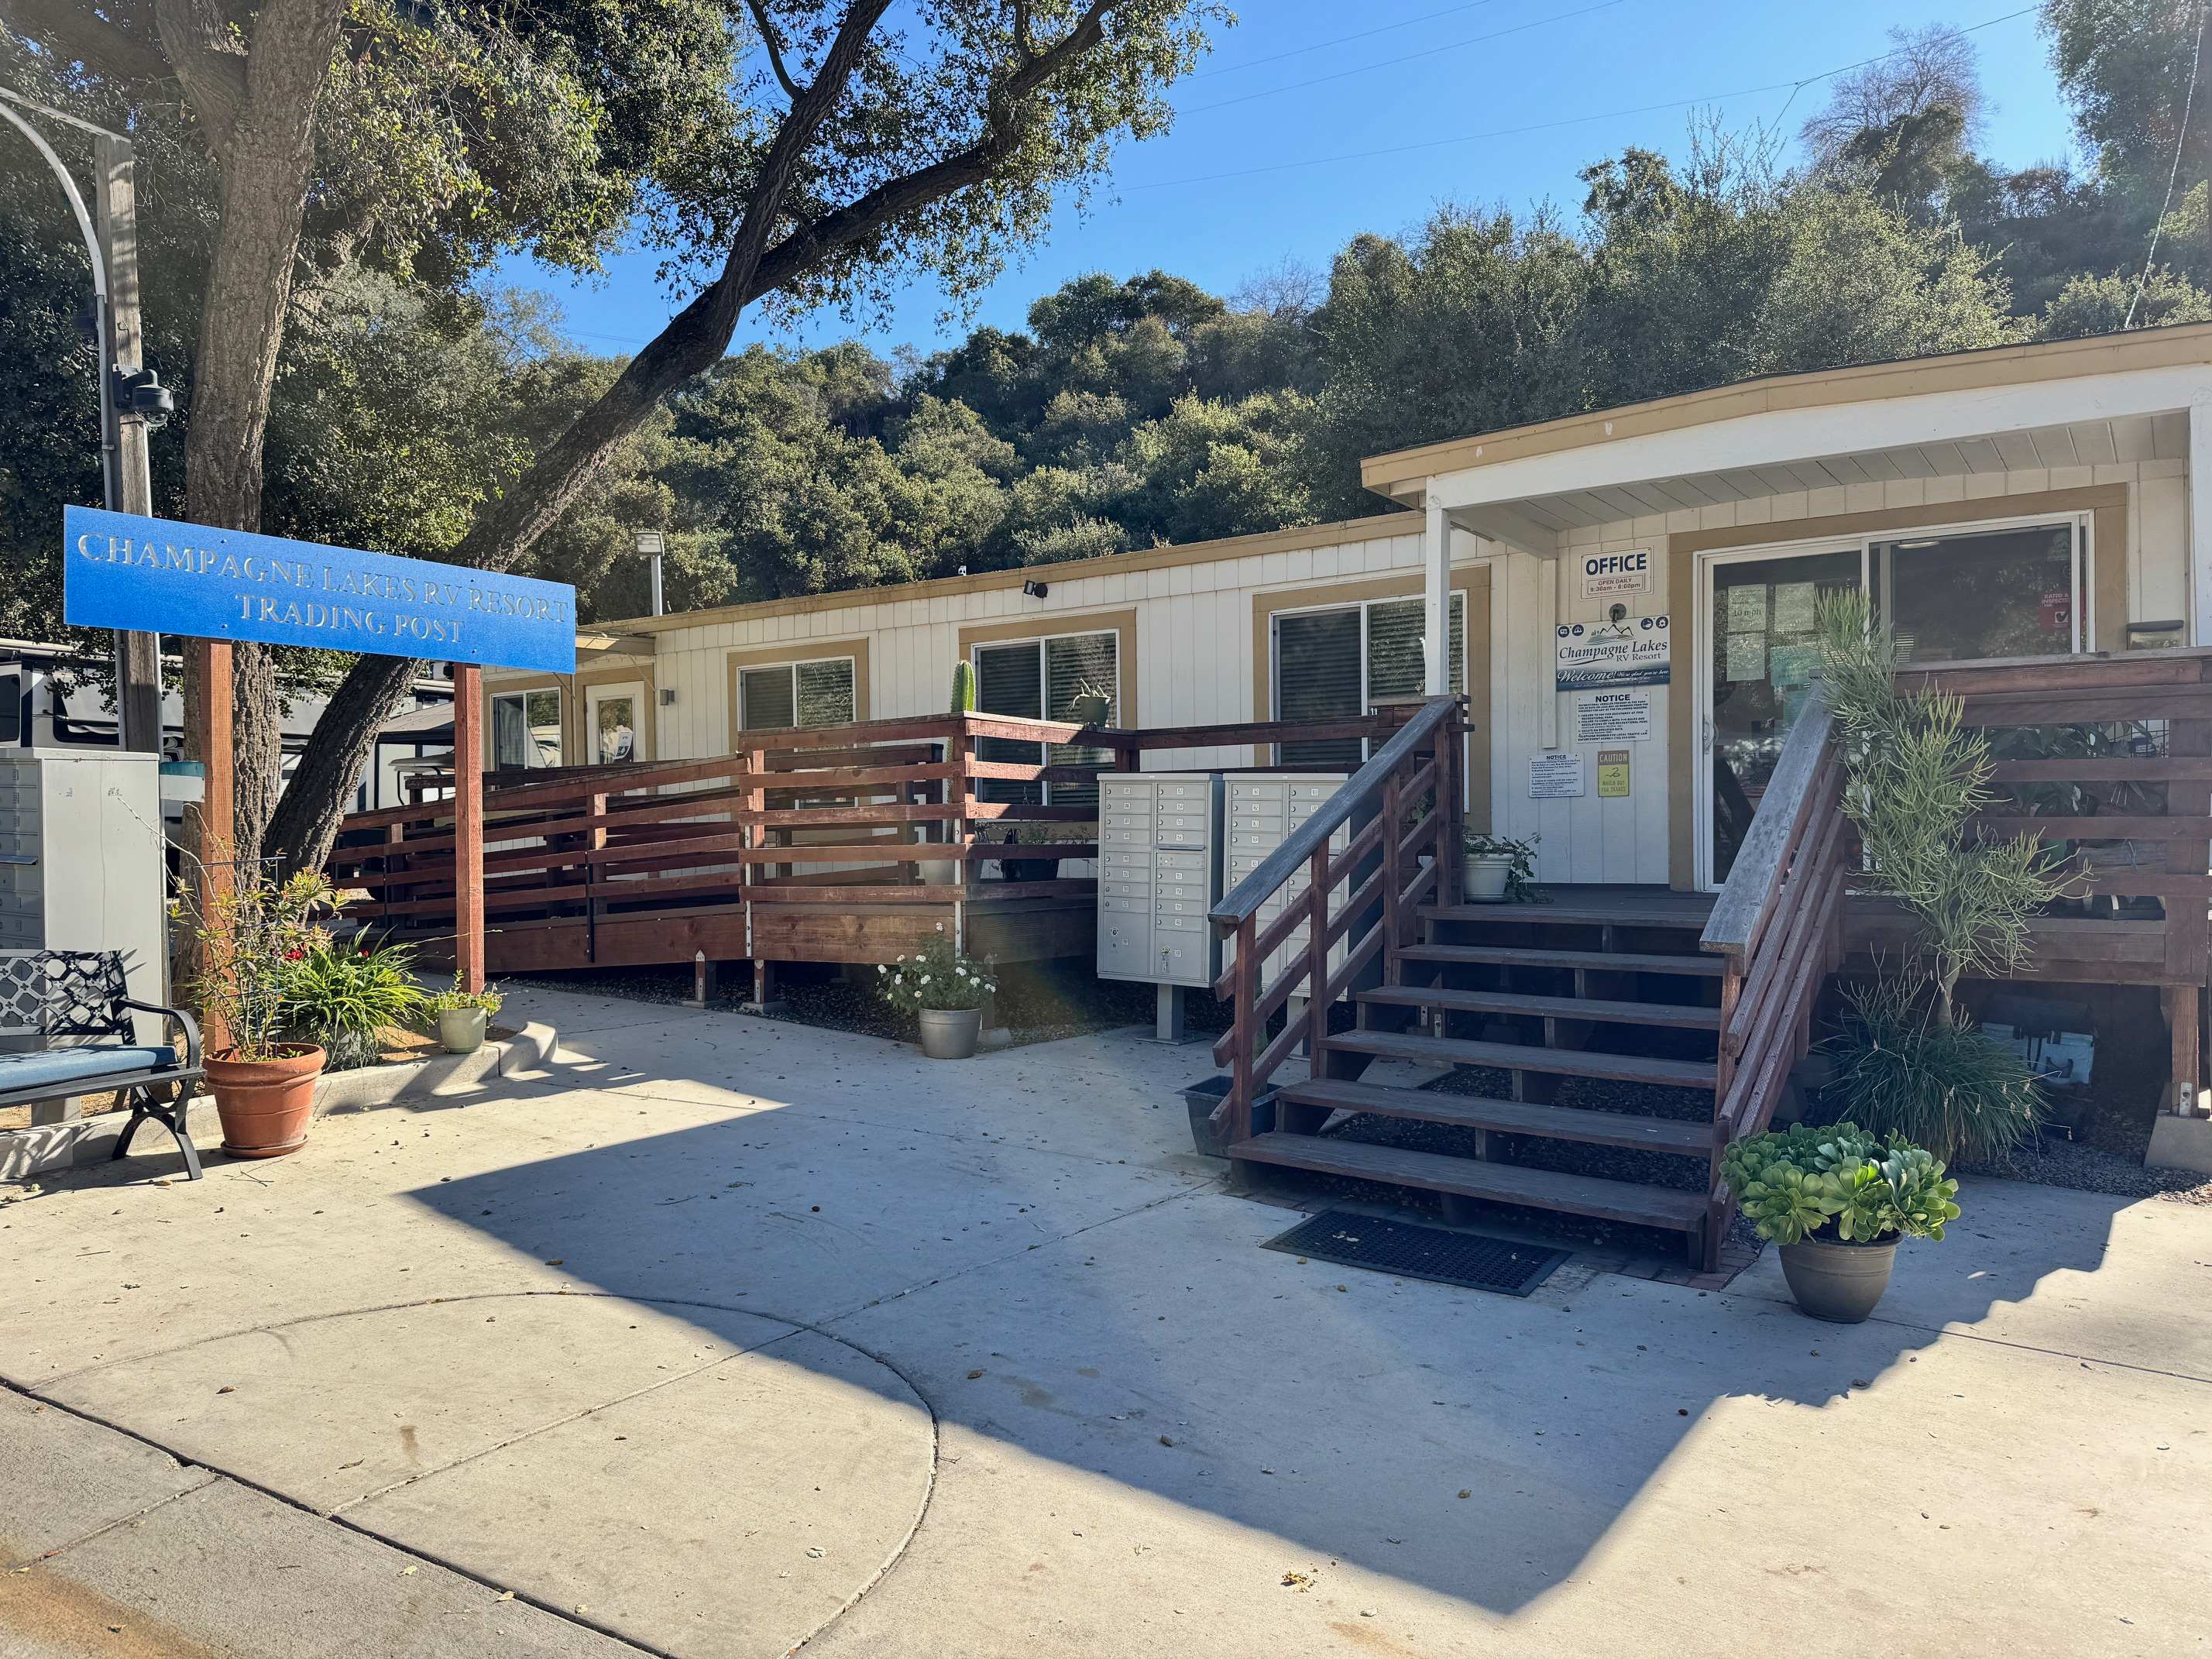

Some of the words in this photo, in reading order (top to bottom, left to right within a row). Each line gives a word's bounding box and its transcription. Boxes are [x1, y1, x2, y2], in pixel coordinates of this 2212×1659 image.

[1585, 553, 1647, 575] OFFICE
[78, 533, 314, 588] CHAMPAGNE
[323, 565, 417, 602] LAKES
[424, 581, 462, 606] RV
[468, 587, 568, 623] RESORT
[235, 594, 385, 634] TRADING
[393, 613, 465, 643] POST
[1559, 645, 1628, 658] Champagne
[1632, 640, 1668, 652] Lakes
[1632, 652, 1661, 661] Resort
[1557, 670, 1617, 682] Welcome!
[1595, 694, 1630, 702] NOTICE
[1599, 753, 1627, 762] CAUTION
